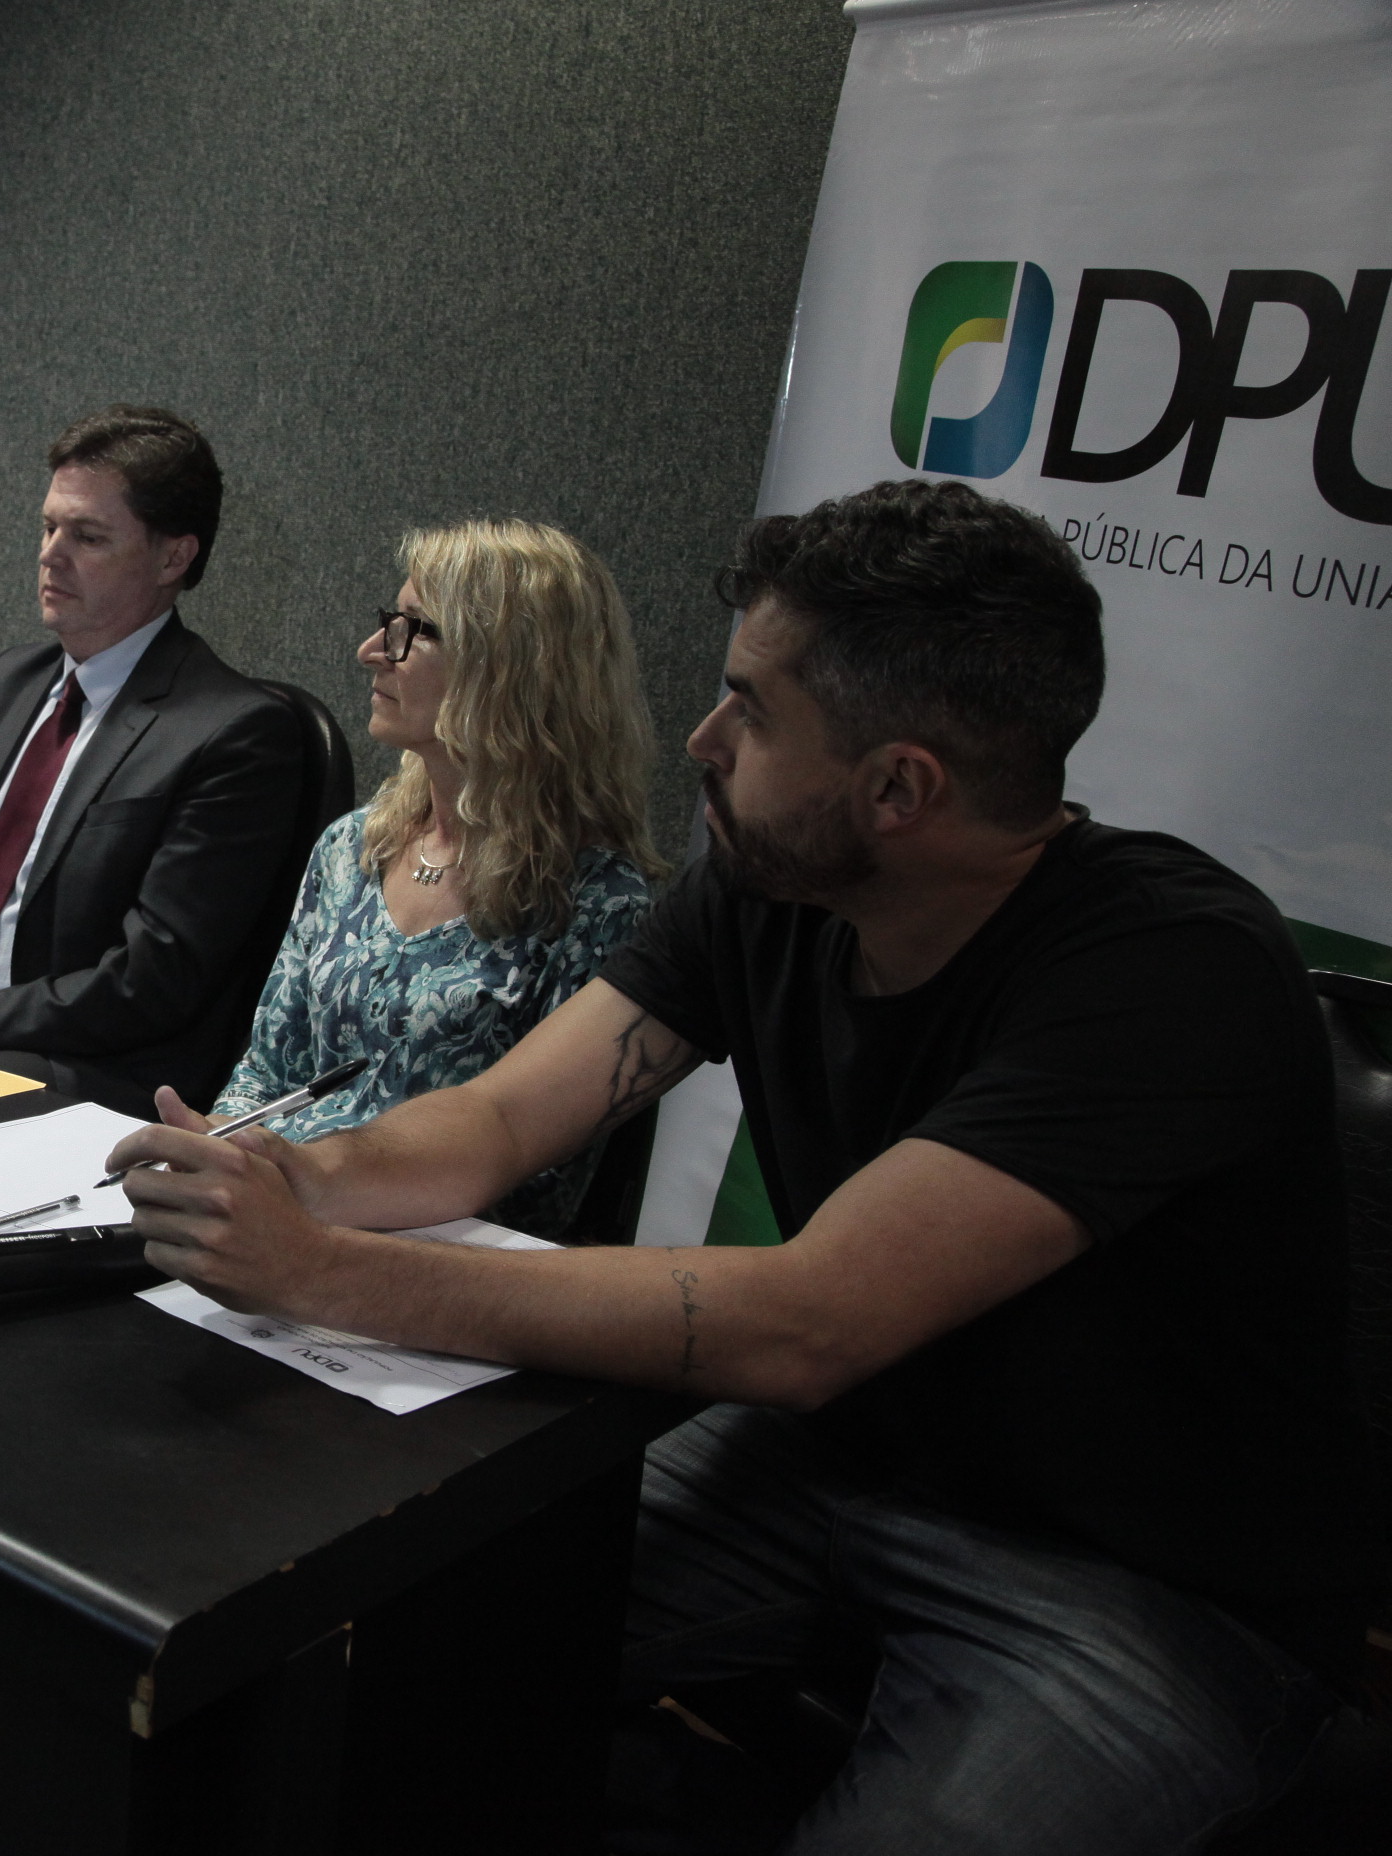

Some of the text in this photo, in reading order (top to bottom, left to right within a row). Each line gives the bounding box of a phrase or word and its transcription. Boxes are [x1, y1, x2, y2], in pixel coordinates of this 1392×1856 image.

[1063, 512, 1204, 580] PÚBLICA
[1218, 543, 1273, 592] DA
[292, 1348, 333, 1366] DPU
